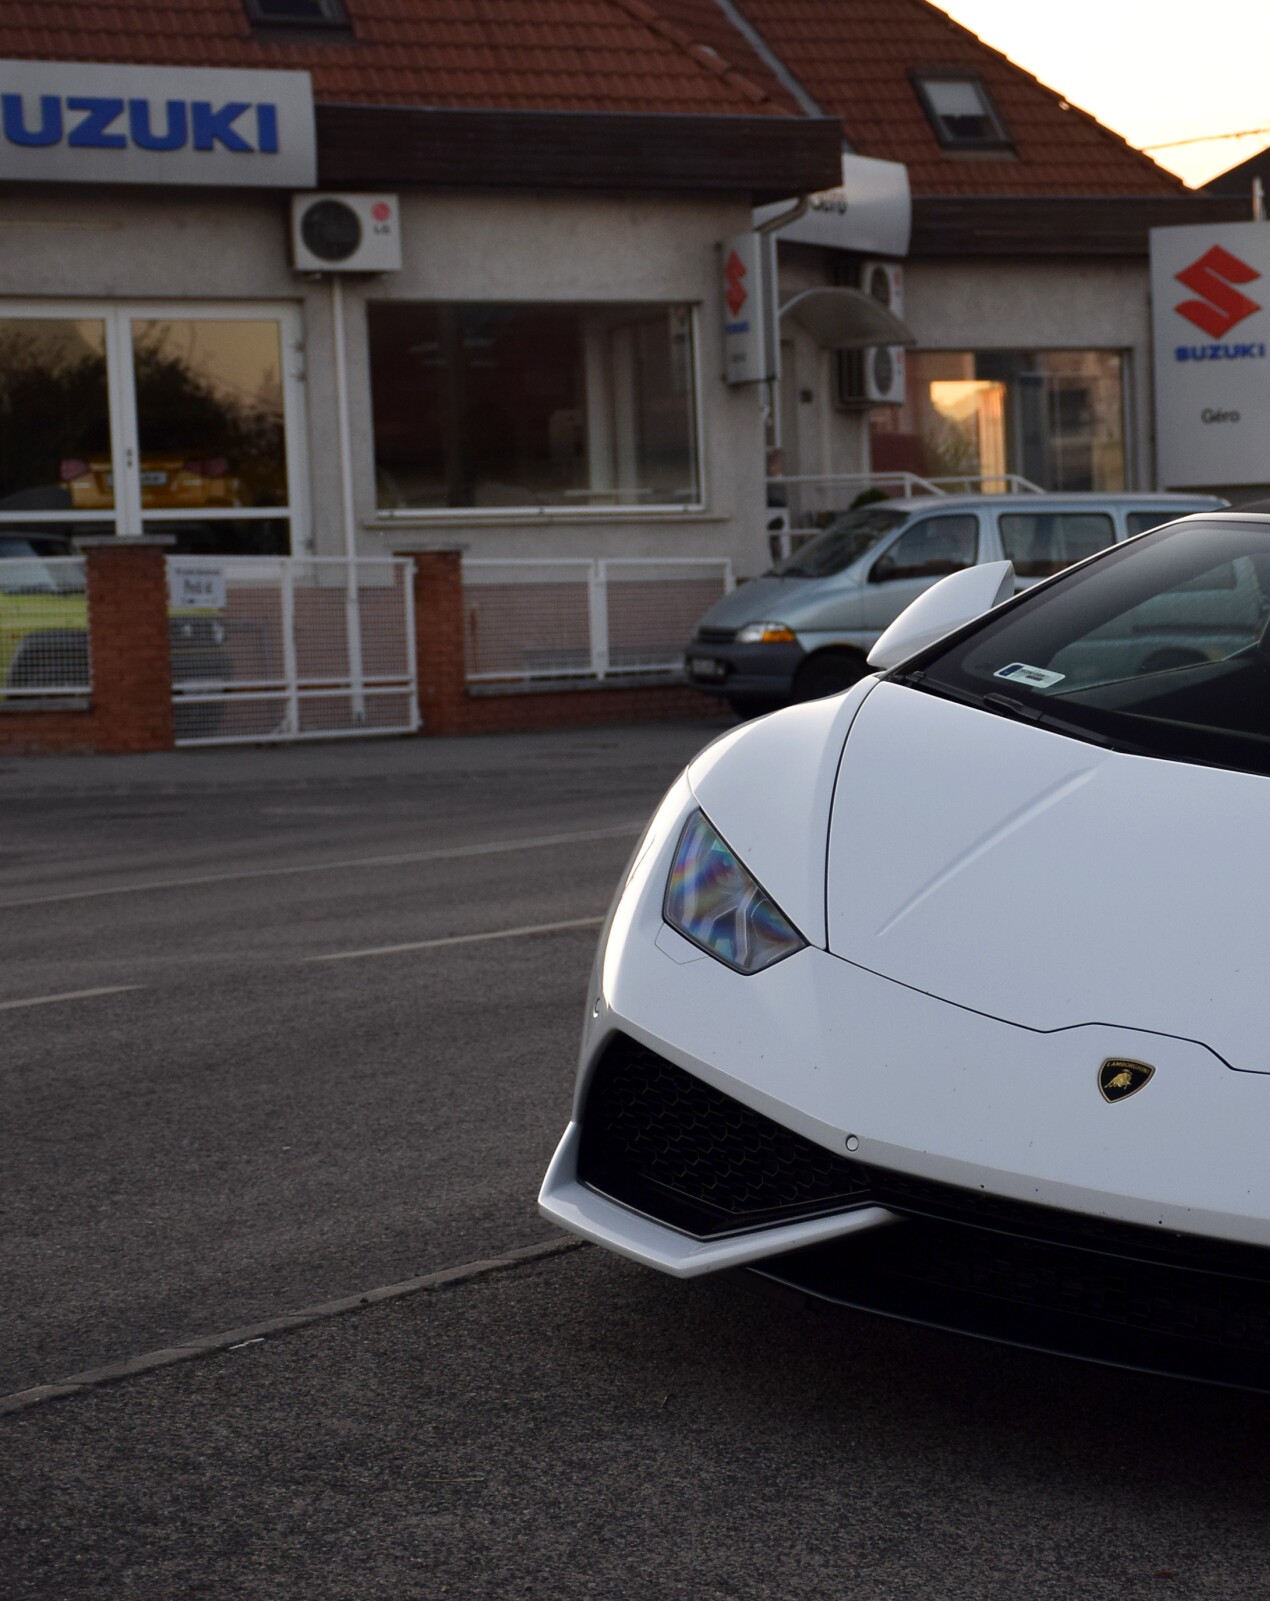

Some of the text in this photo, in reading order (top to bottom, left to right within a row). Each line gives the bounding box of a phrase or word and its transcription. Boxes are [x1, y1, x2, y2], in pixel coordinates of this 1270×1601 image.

[2, 94, 279, 153] UZUKI
[373, 224, 391, 235] LG
[1174, 342, 1266, 362] SUZUKI
[1106, 1060, 1151, 1074] LAMBORGHINI
